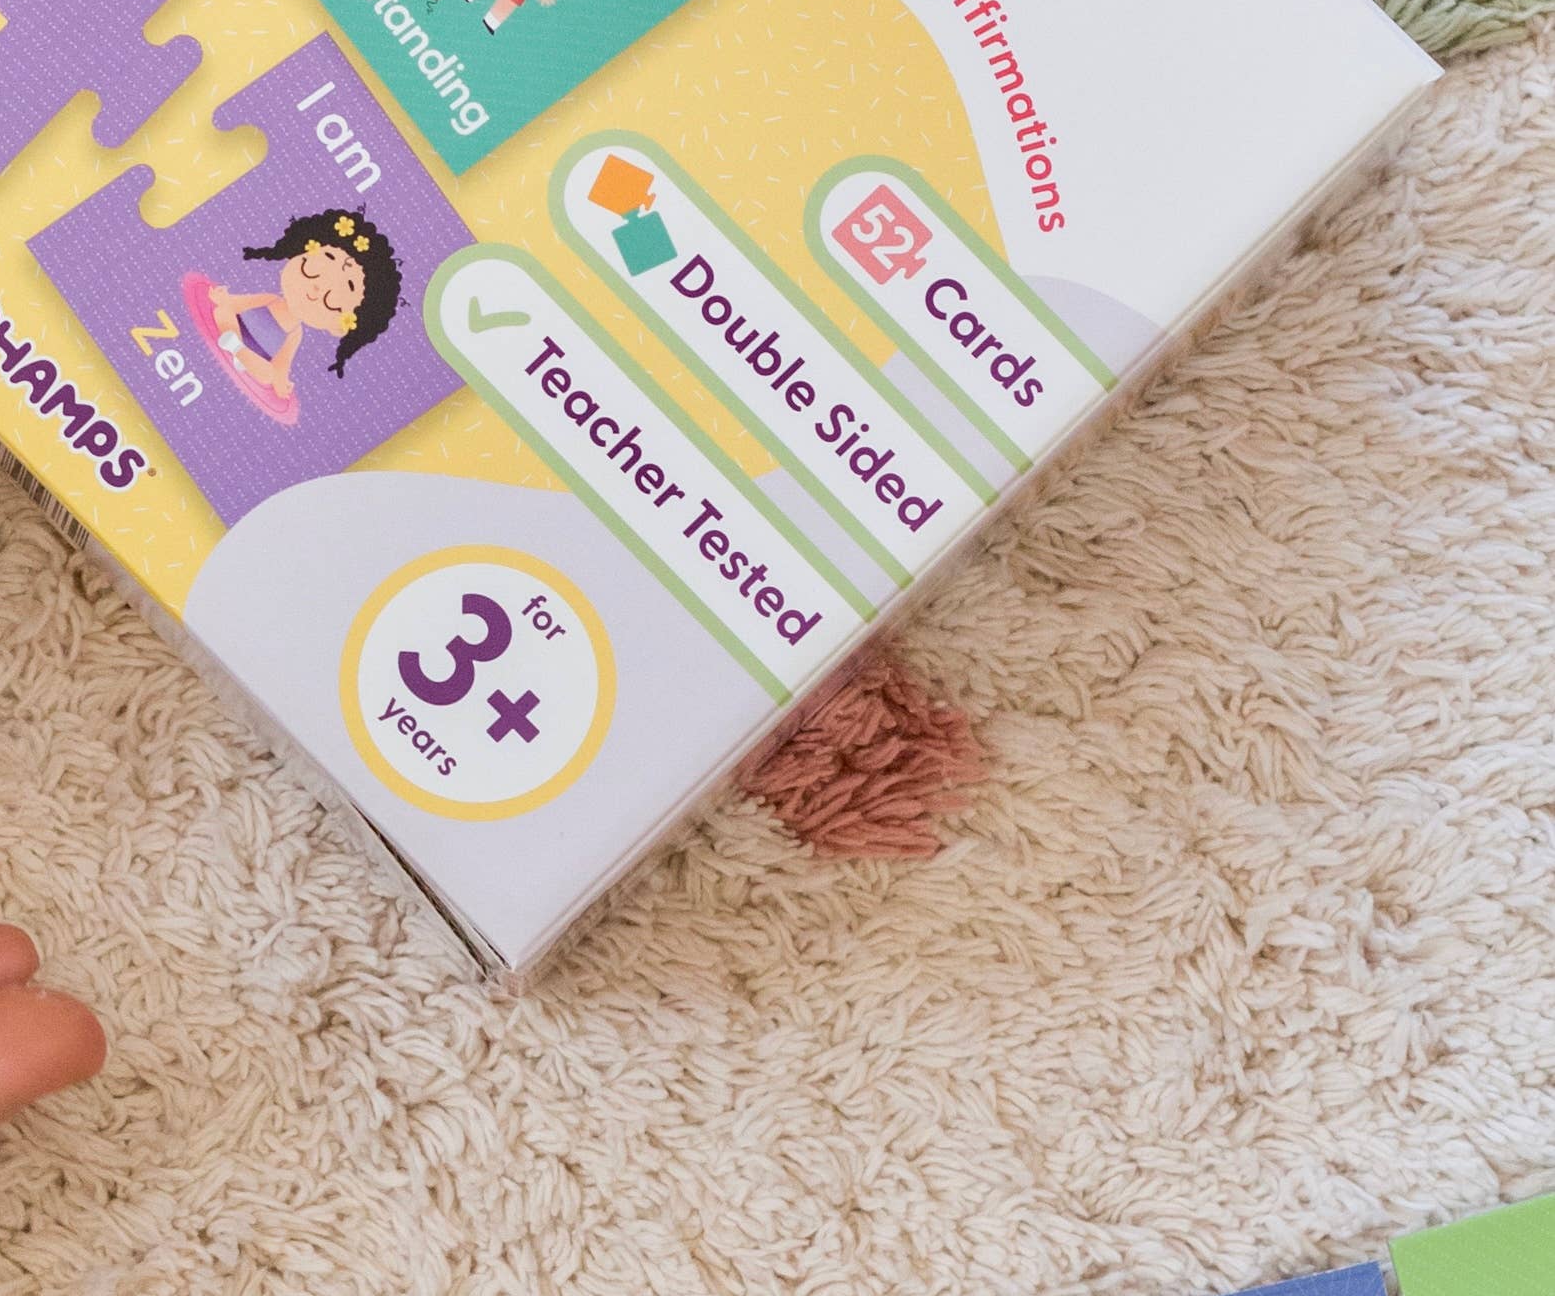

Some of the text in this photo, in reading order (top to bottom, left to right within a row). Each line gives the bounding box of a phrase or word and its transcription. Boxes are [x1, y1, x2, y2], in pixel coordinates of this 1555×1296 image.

[296, 81, 382, 194] I am
[851, 203, 915, 267] 52
[669, 254, 944, 533] Double Sided
[924, 278, 1044, 408] Cards
[523, 336, 823, 647] Teacher Tested
[397, 593, 542, 744] 3+
[521, 594, 566, 641] for
[378, 697, 457, 776] years
